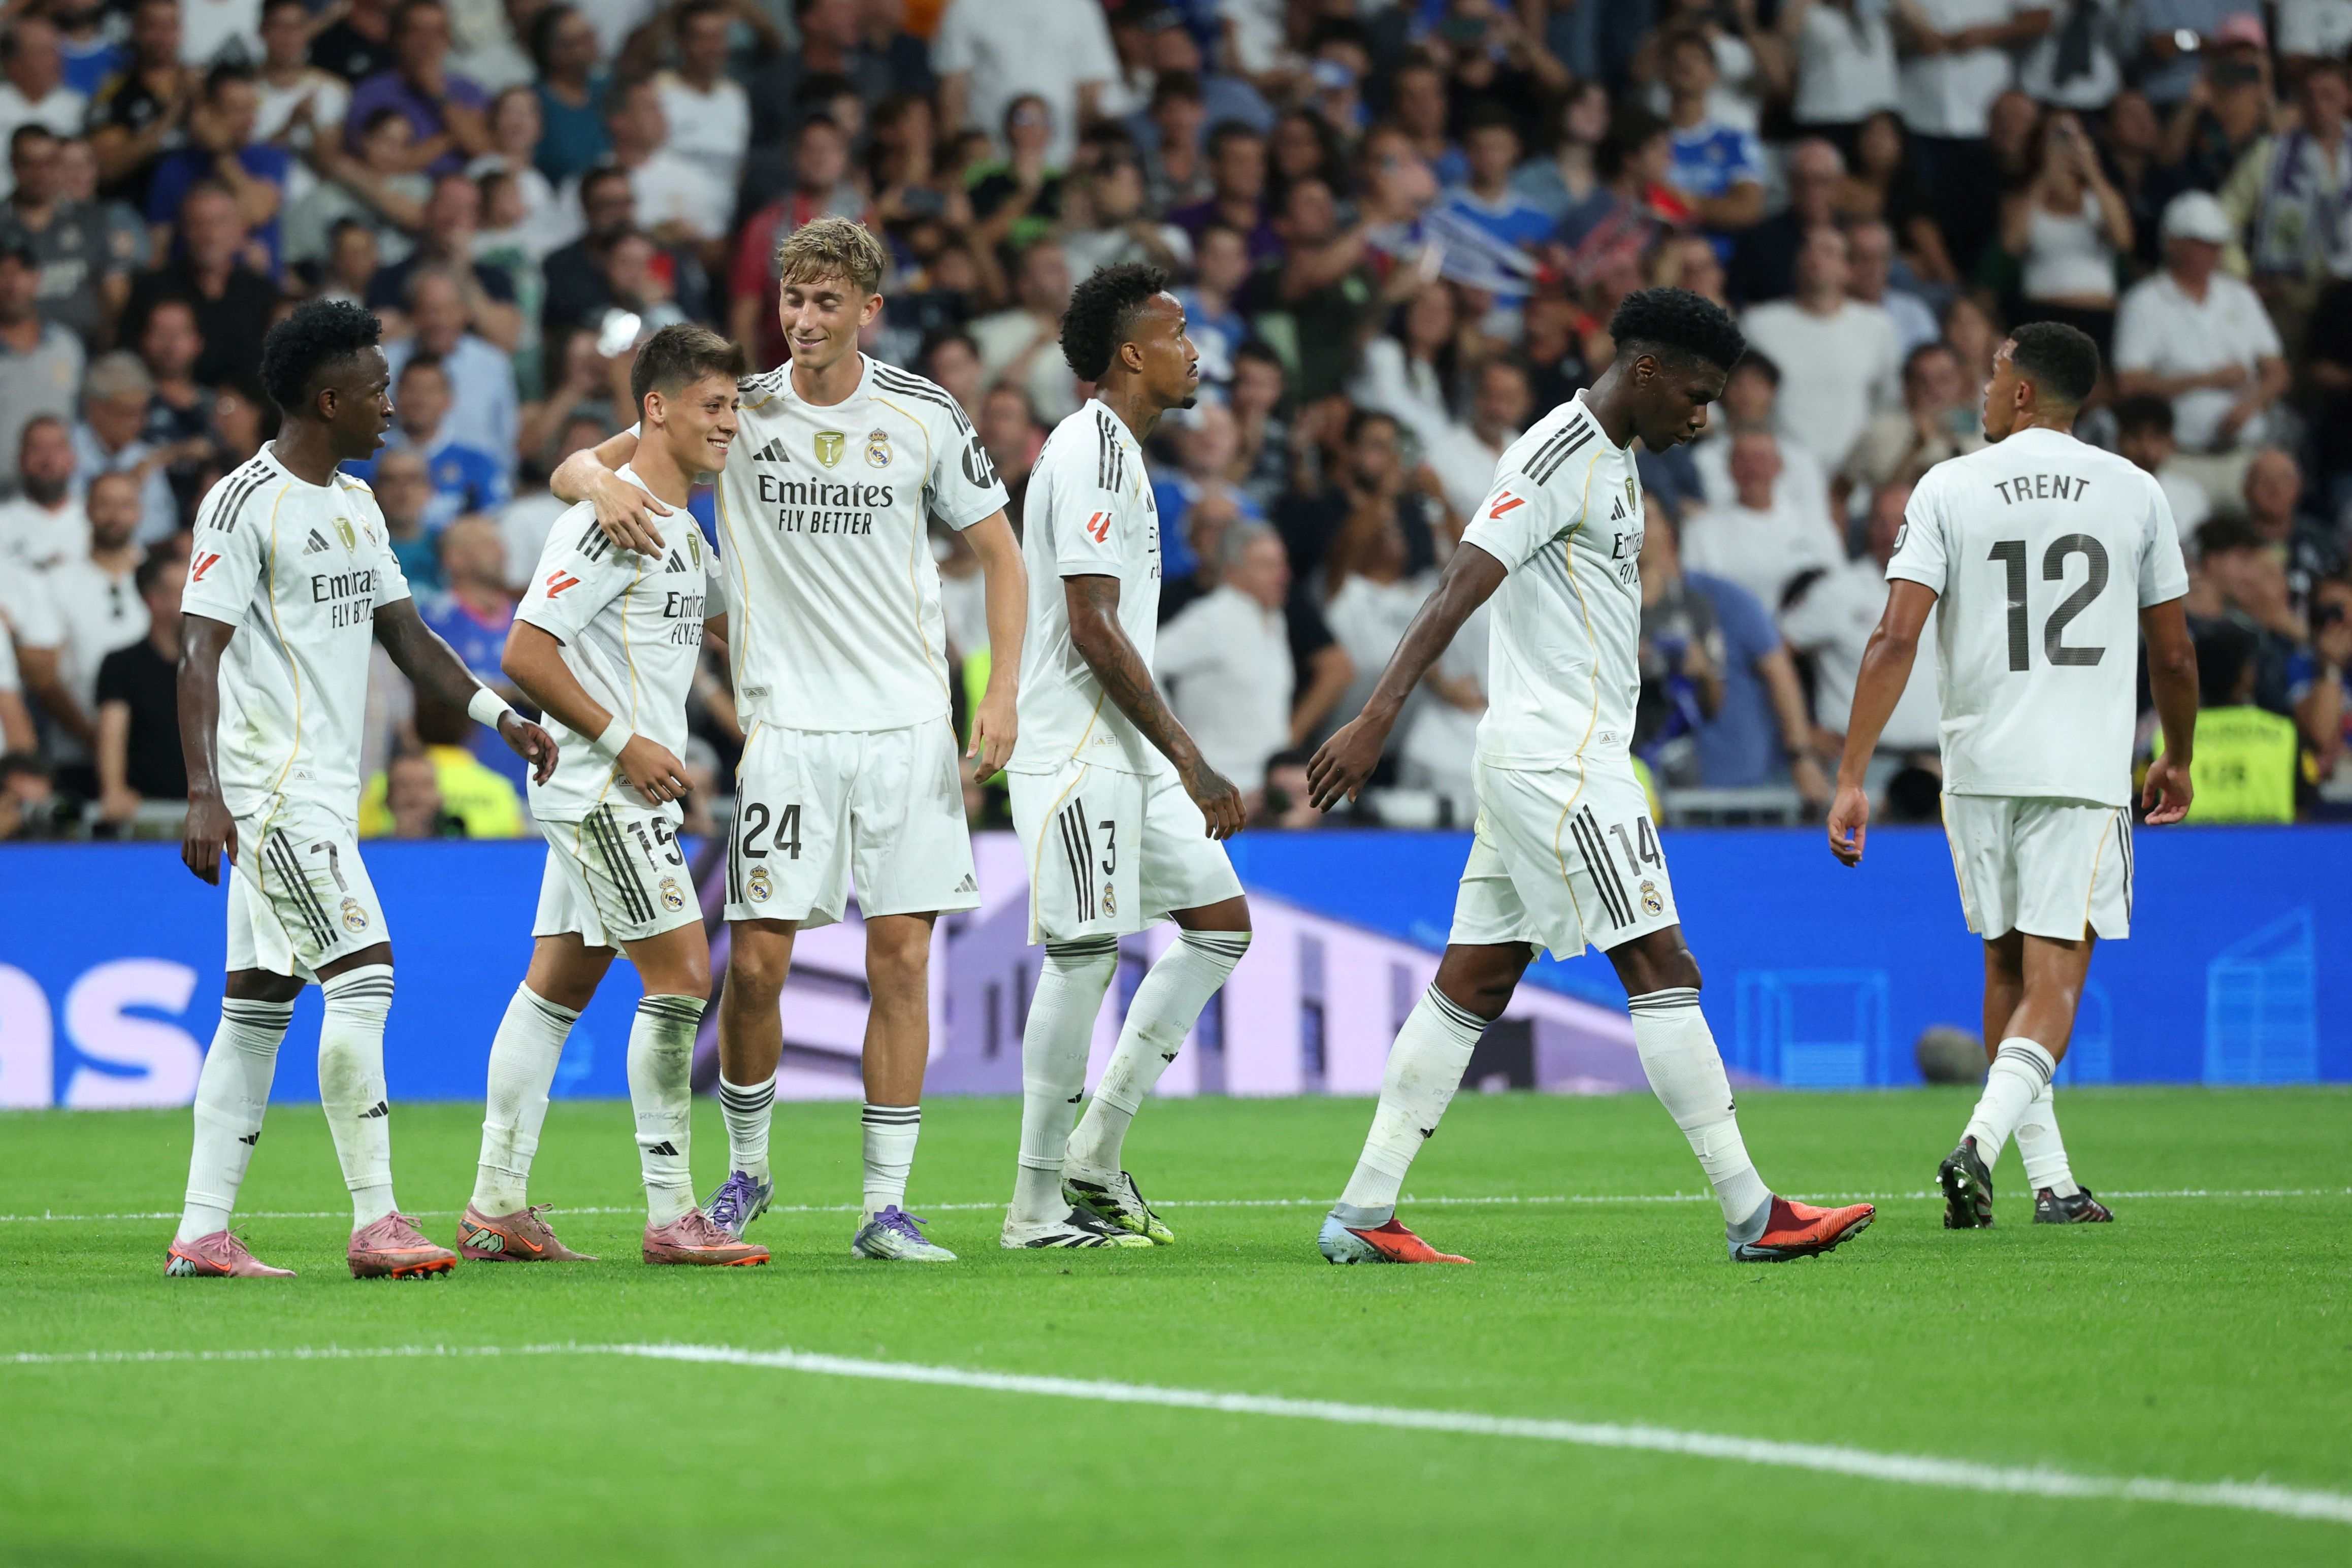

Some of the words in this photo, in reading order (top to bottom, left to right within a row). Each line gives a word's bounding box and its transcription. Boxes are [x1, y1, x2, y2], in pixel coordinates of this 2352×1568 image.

[758, 474, 893, 507] Emirates
[1994, 474, 2090, 505] TRENT
[778, 509, 805, 532] FLY
[810, 511, 872, 534] BETTER
[333, 603, 349, 629] FLY
[1987, 534, 2109, 671] 12
[671, 623, 690, 645] FLY
[627, 816, 683, 872] 15
[742, 802, 801, 859] 24
[1098, 821, 1116, 875] 3
[1609, 815, 1661, 876] 14
[310, 840, 349, 893] 7
